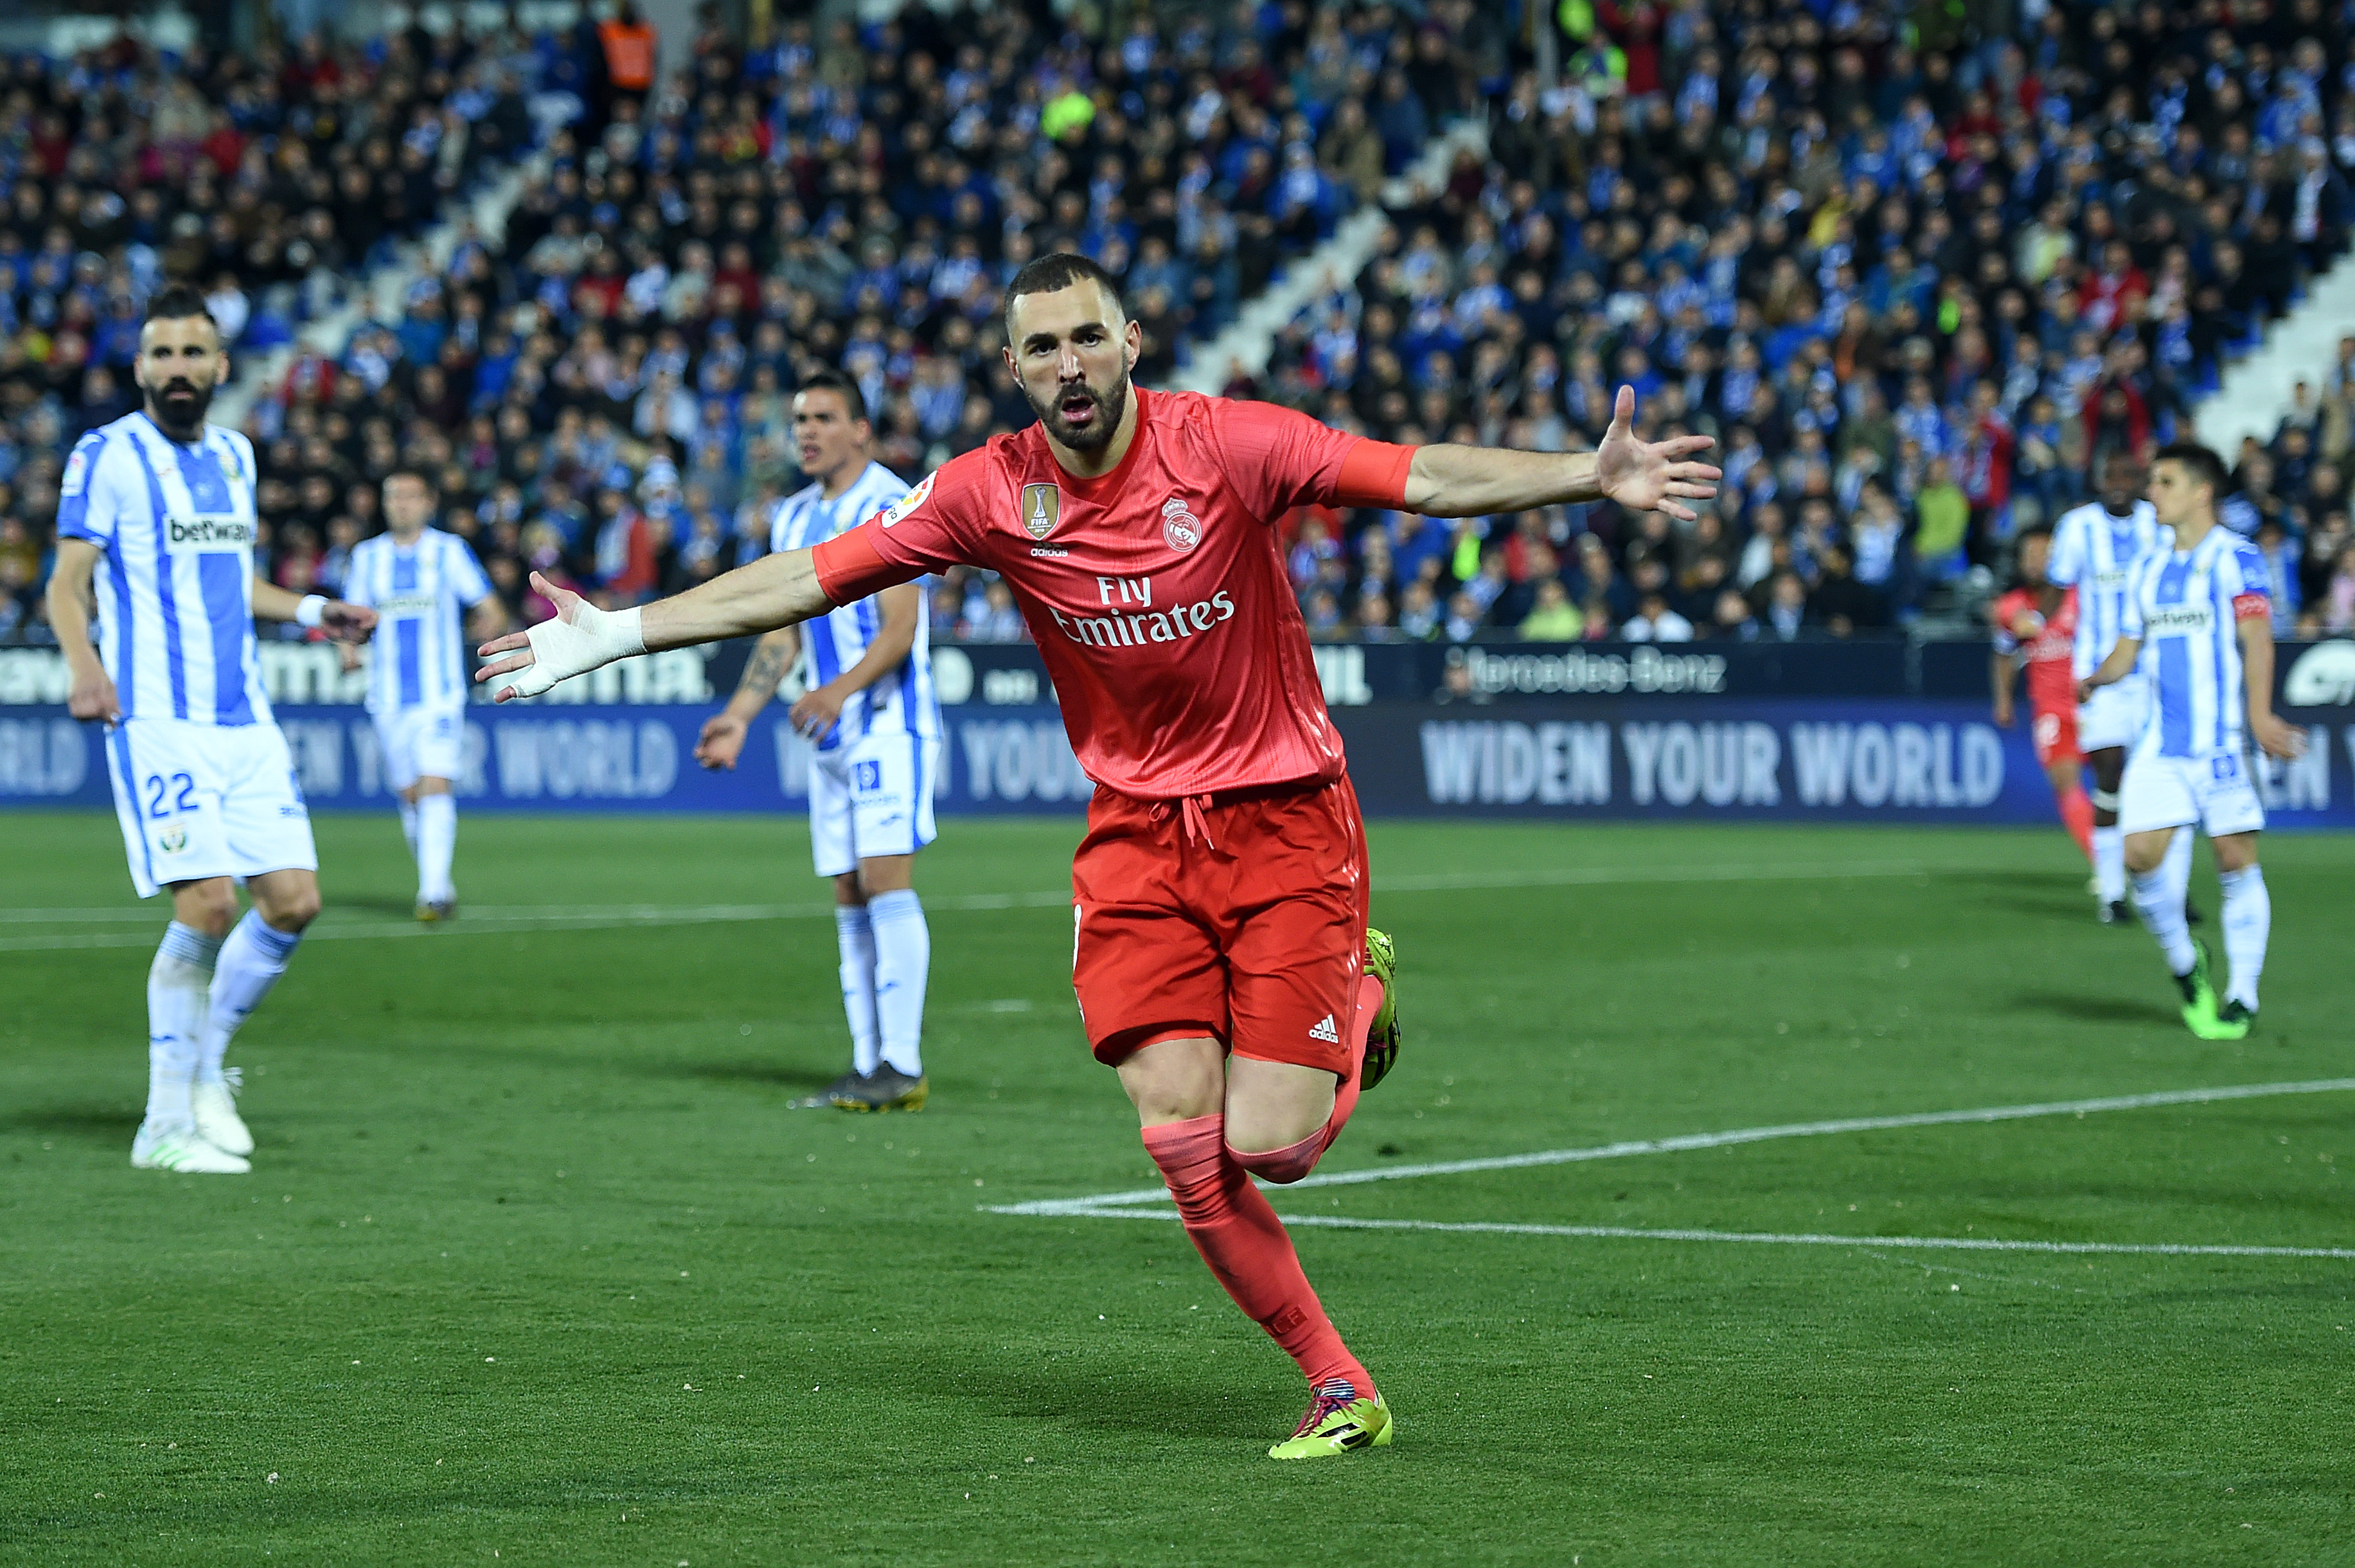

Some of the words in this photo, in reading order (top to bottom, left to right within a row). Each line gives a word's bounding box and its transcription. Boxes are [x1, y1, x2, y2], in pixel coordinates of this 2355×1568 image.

[170, 519, 251, 542] betwa
[1030, 547, 1069, 557] adidas
[1096, 576, 1151, 607] Fly
[1048, 590, 1235, 647] Emirates
[1419, 720, 1612, 805] WIDEN
[1621, 720, 1782, 806] YOUR
[1790, 720, 2005, 808] WORLD
[147, 772, 200, 819] 22
[1309, 1029, 1338, 1044] adidas
